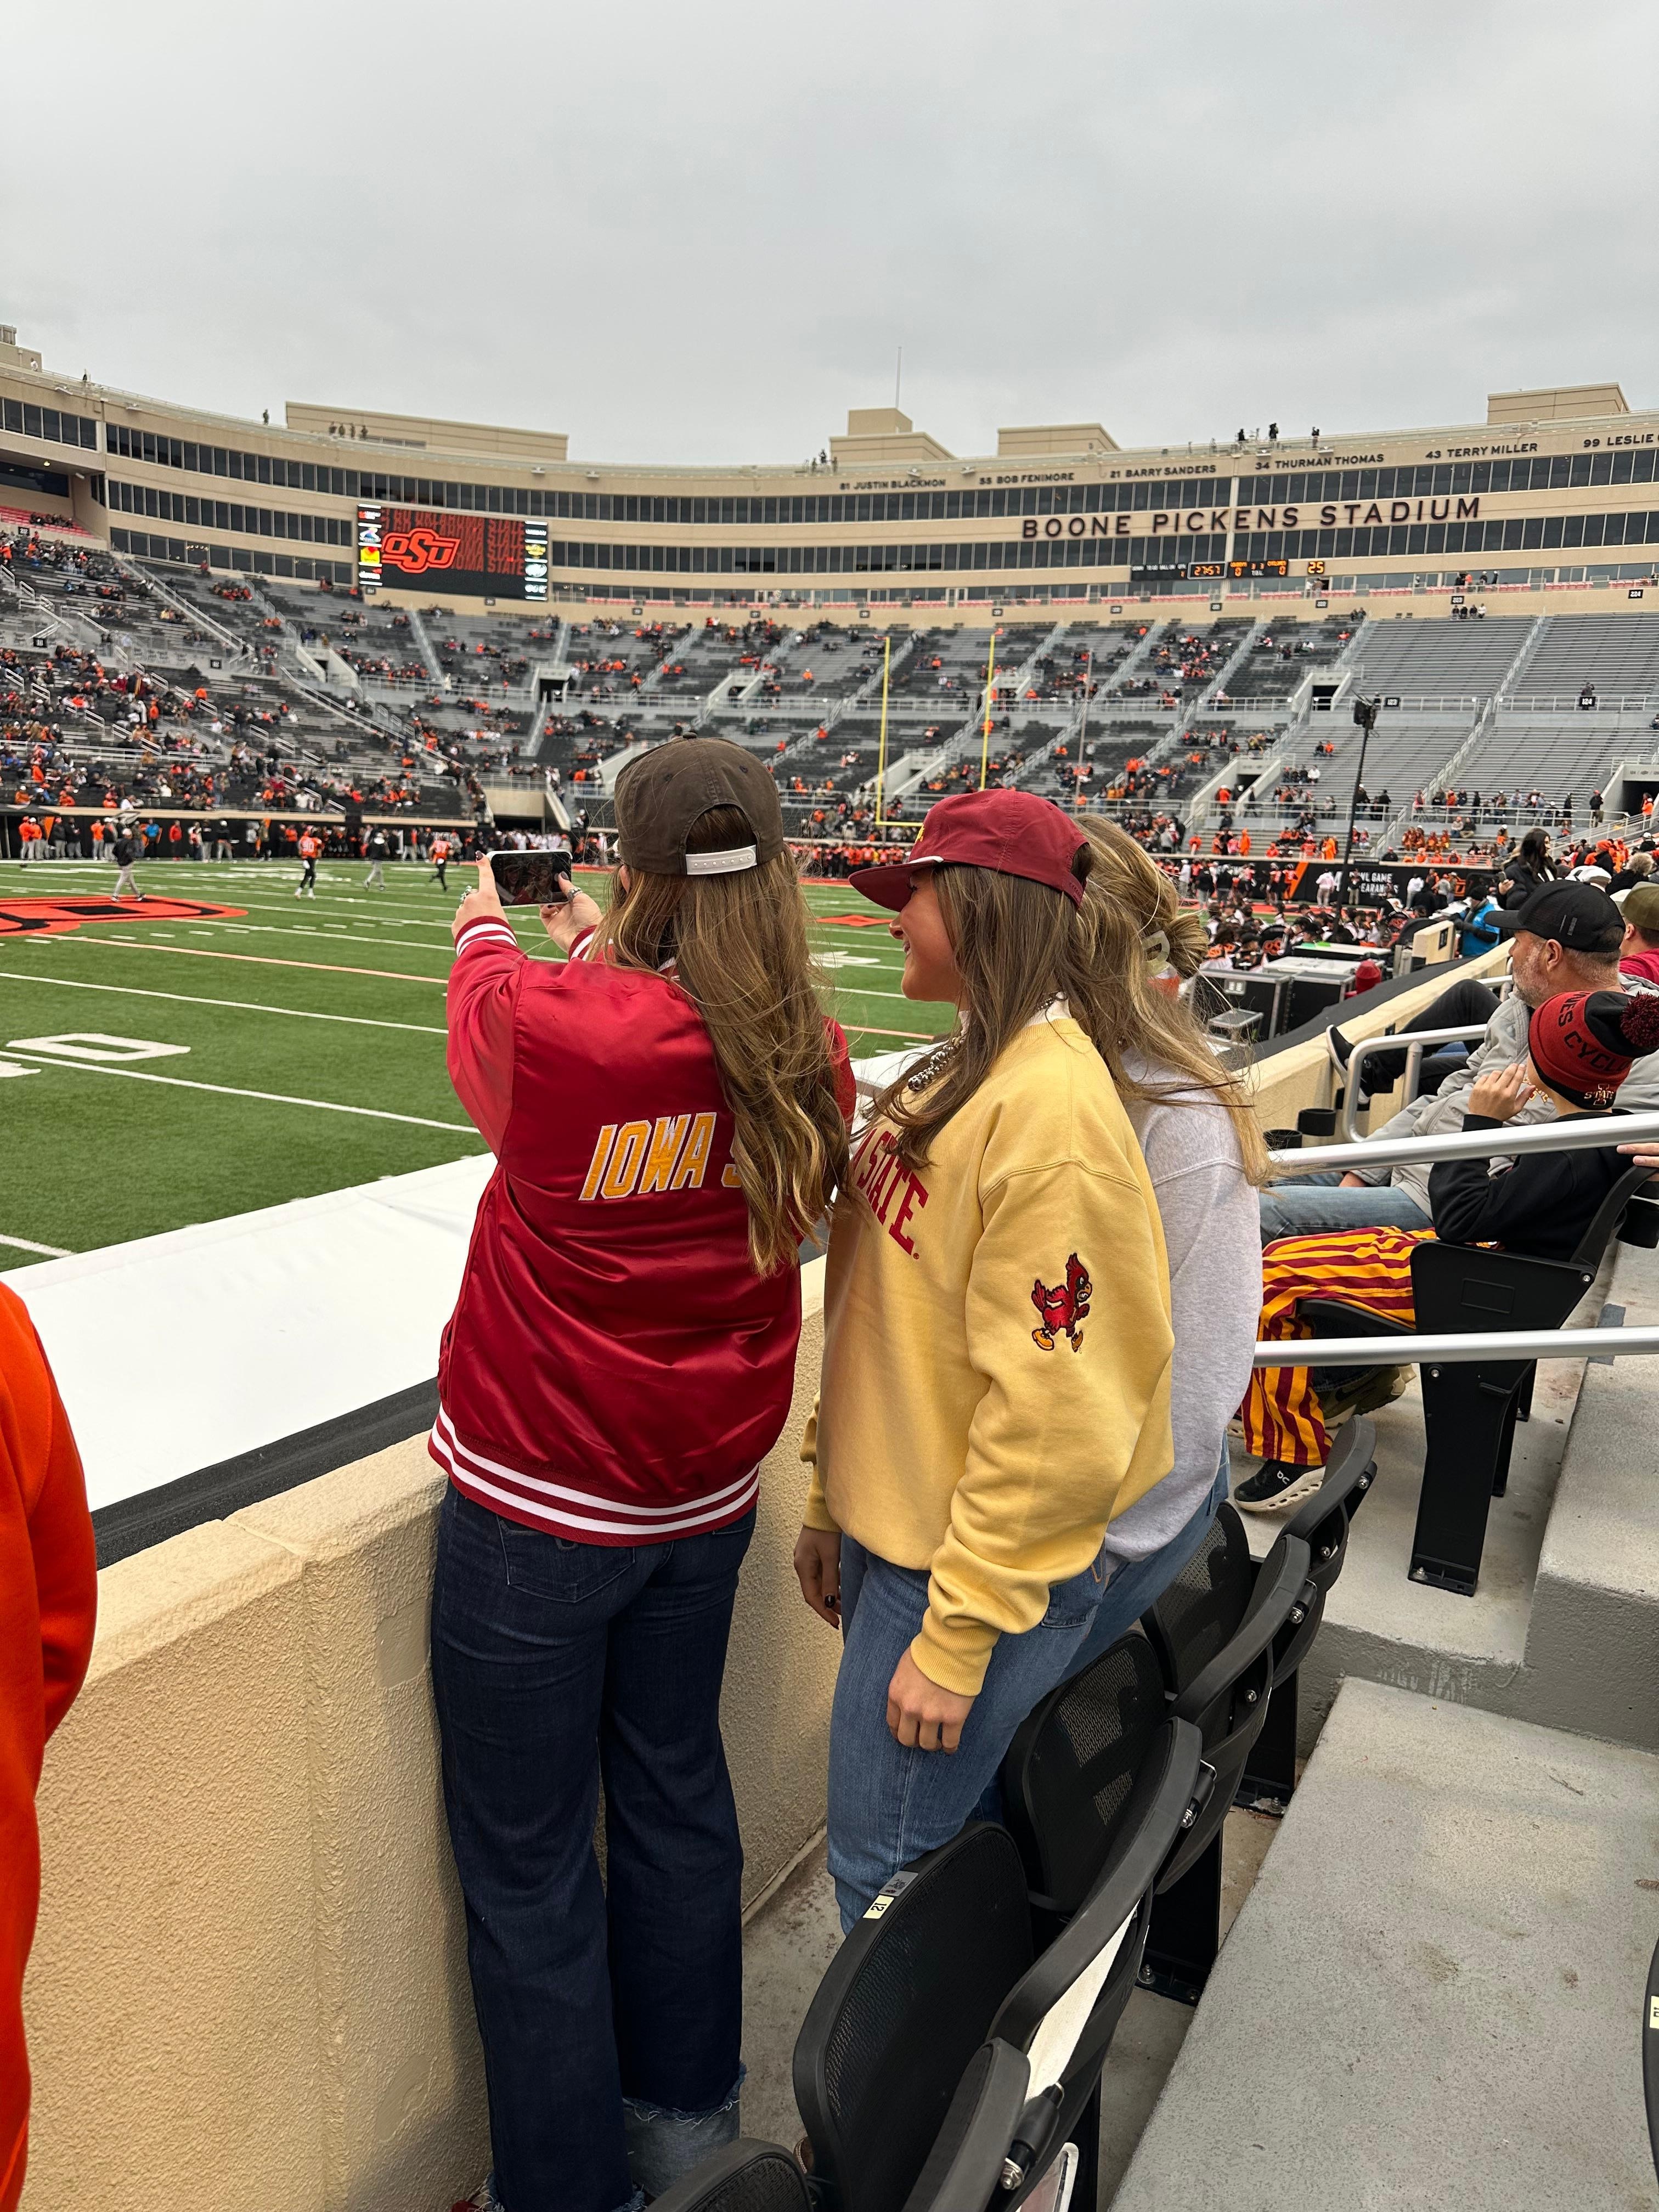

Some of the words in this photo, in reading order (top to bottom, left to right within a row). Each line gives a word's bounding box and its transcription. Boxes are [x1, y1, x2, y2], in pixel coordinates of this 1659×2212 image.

[1584, 439, 1600, 448] 99
[1607, 434, 1654, 446] LESLIE
[1426, 450, 1441, 459] 43
[1447, 446, 1487, 458] TERRY
[1491, 443, 1538, 455] MILLER
[1255, 461, 1270, 470] 34
[1275, 458, 1331, 469] THURMAN
[1334, 454, 1385, 466] THOMAS
[996, 476, 1018, 484] BOB
[1020, 472, 1075, 483] FENIMORE
[1110, 470, 1121, 478] 21
[1125, 467, 1161, 477] BARRY
[1164, 465, 1216, 476] SANDERS
[854, 481, 889, 490] JUSTIN
[1023, 515, 1131, 539] BOONE
[1153, 506, 1299, 533] PICKENS
[1320, 496, 1480, 526] STADIUM
[381, 527, 461, 574] OSU
[1308, 561, 1324, 573] 25
[1372, 872, 1393, 883] GAME
[578, 1111, 718, 1201] IOWA
